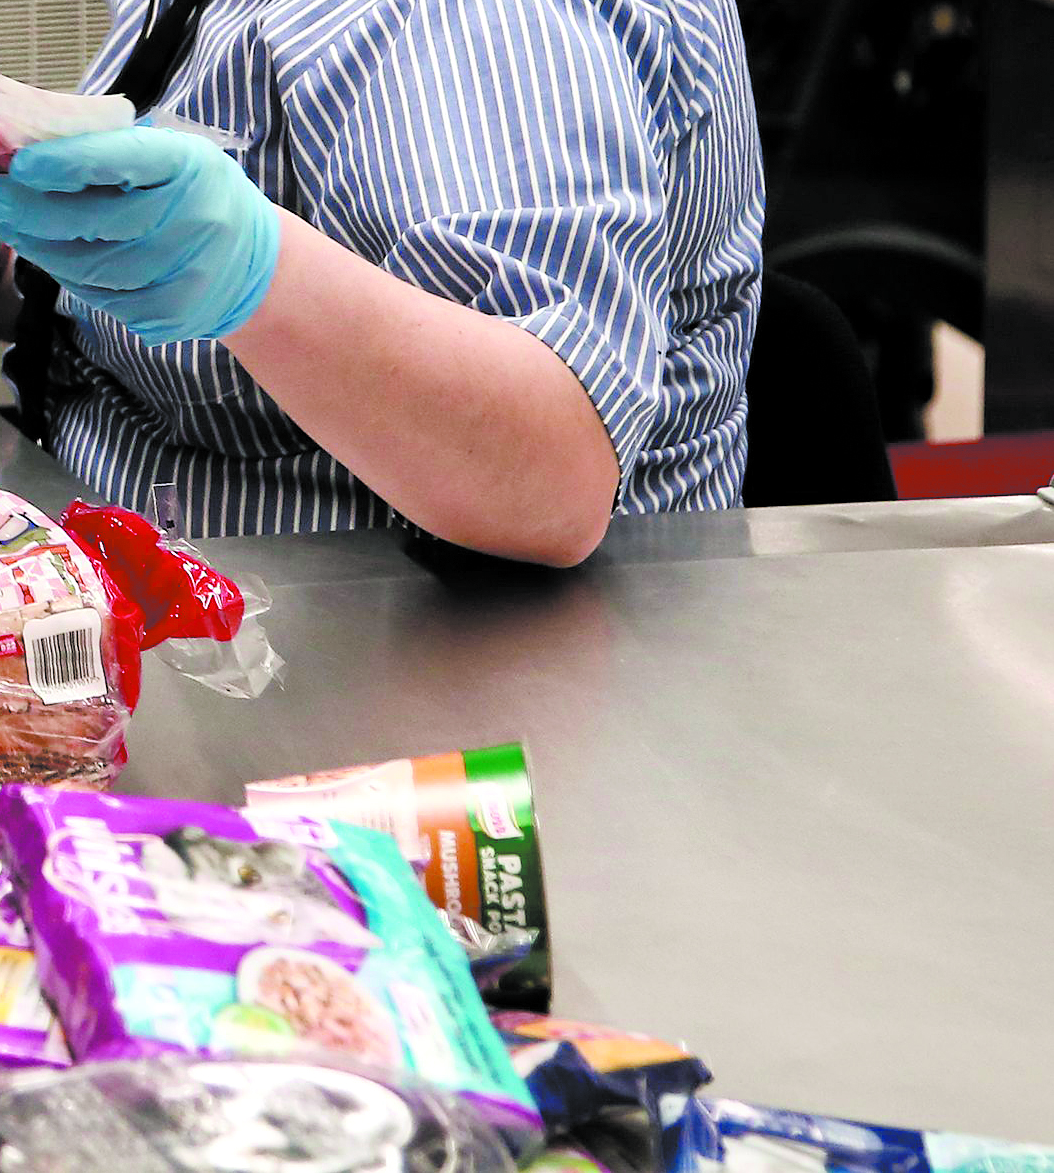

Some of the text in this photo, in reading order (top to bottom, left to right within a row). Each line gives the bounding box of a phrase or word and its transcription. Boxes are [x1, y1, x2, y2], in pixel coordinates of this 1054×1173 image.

[439, 830, 463, 917] MUSHRO
[479, 845, 503, 934] SNACK PO
[497, 853, 528, 928] PAST
